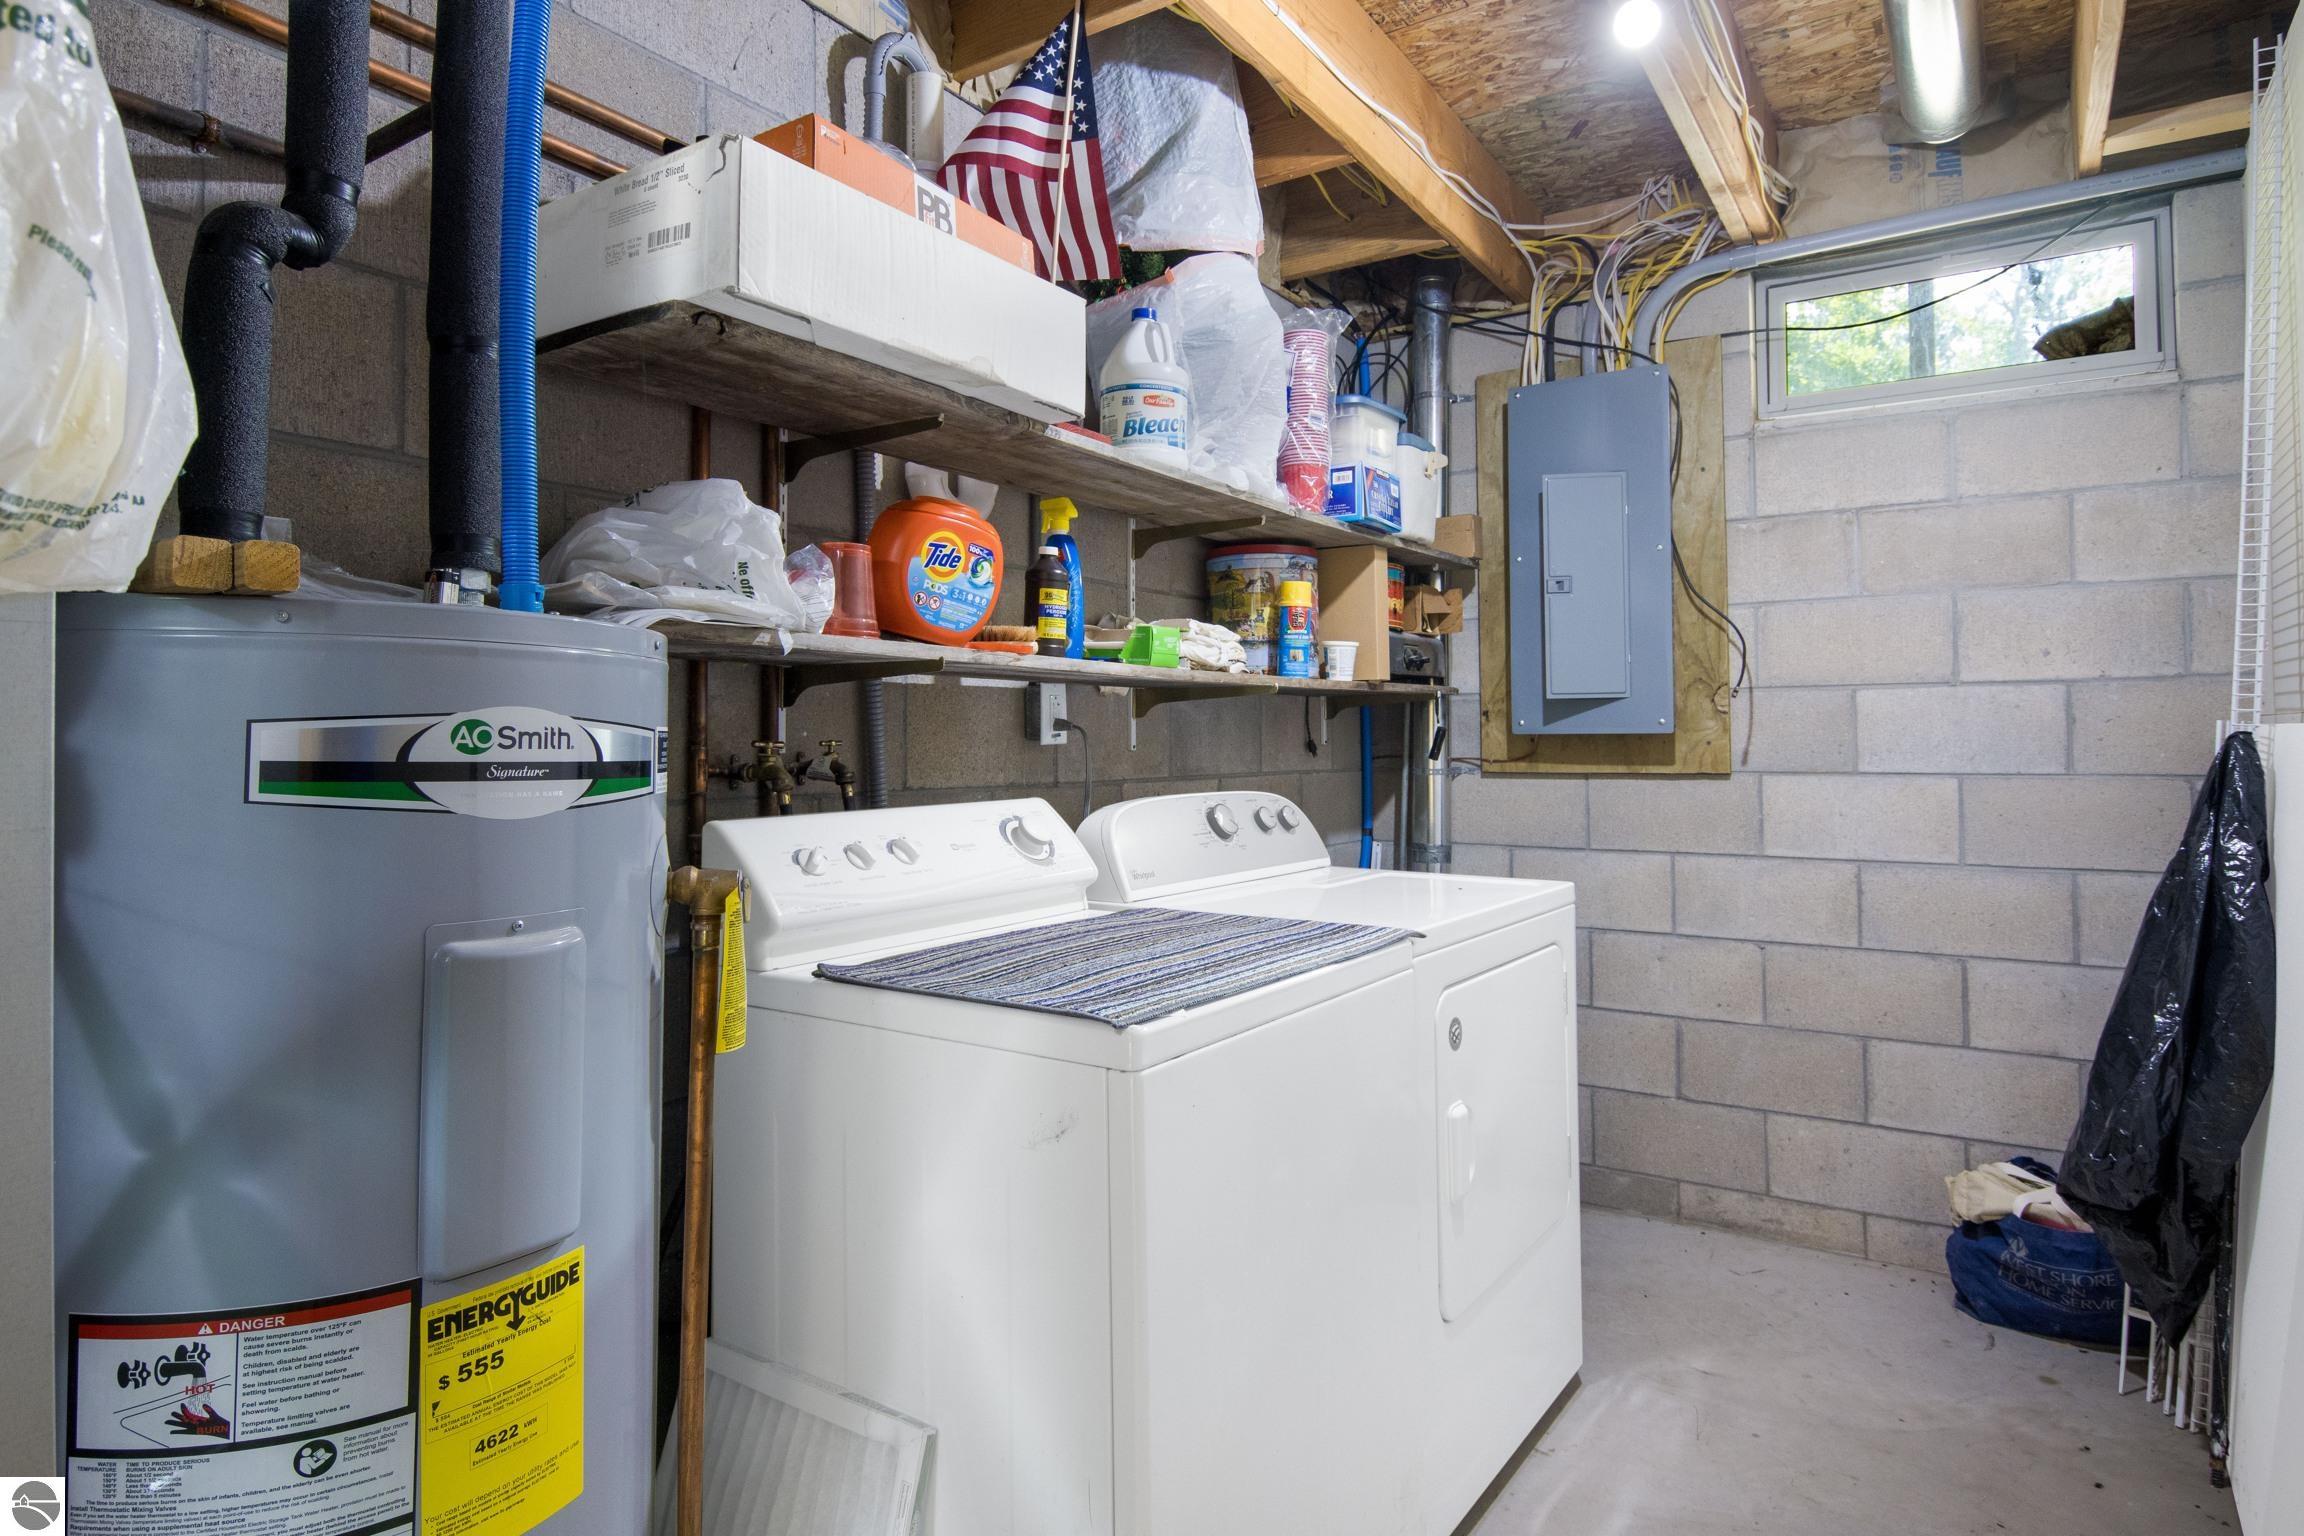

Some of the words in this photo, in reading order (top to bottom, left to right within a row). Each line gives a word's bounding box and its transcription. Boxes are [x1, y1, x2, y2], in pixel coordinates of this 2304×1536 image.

[614, 184, 631, 197] White
[632, 176, 649, 190] Bread
[665, 163, 685, 178] Sliced
[917, 185, 953, 235] PB
[924, 543, 962, 569] Tide
[923, 580, 949, 595] PODS
[453, 725, 496, 749] AO
[2050, 1271, 2117, 1287] SHORE
[1999, 1267, 2056, 1298] HOME
[2060, 1295, 2122, 1311] SERVIC
[428, 1261, 580, 1343] ENERGYGUIDE
[220, 1316, 286, 1333] DANGER
[266, 1329, 309, 1339] temperature
[310, 1326, 326, 1334] over
[267, 1340, 290, 1348] severe
[292, 1336, 313, 1344] burns
[314, 1329, 344, 1340] instantly
[462, 1342, 495, 1359] Estimated
[497, 1333, 517, 1346] Yearly
[518, 1322, 538, 1338] Energy
[243, 1349, 263, 1358] death
[265, 1347, 281, 1355] from
[243, 1361, 275, 1370] Children,
[277, 1355, 307, 1366] disabled
[309, 1352, 322, 1360] and
[324, 1348, 347, 1358] elderly
[251, 1368, 278, 1378] highest
[280, 1364, 293, 1372] risk
[295, 1362, 302, 1370] of
[304, 1360, 324, 1369] being
[325, 1355, 354, 1365] scalded.
[438, 1375, 451, 1391] $
[457, 1349, 505, 1383] 555
[242, 1389, 267, 1397] setting
[268, 1382, 311, 1394] temperature
[321, 1376, 341, 1384] water
[342, 1371, 366, 1380] heater.
[258, 1377, 296, 1387] instruction
[297, 1372, 324, 1381] manual
[325, 1367, 348, 1376] before
[185, 1384, 216, 1395] HOT
[280, 1395, 303, 1403] before
[304, 1389, 331, 1399] bathing
[242, 1407, 281, 1416] showering.
[242, 1416, 286, 1428] Temperature
[287, 1410, 314, 1421] limiting
[315, 1407, 338, 1415] valves
[196, 1425, 228, 1434] BURN
[241, 1427, 274, 1436] available,
[291, 1418, 318, 1428] manual.
[358, 1428, 382, 1439] manual
[393, 1421, 409, 1430] more
[343, 1443, 377, 1456] preventing
[378, 1438, 396, 1447] burns
[344, 1436, 379, 1449] information
[380, 1431, 398, 1439] about
[474, 1423, 520, 1454] 4622
[343, 1454, 358, 1462] from
[359, 1451, 370, 1459] hot
[472, 1451, 497, 1467] Estimated
[498, 1444, 513, 1456] Yearly
[513, 1437, 529, 1448] Energy
[424, 1513, 443, 1524] Your
[444, 1506, 461, 1517] cost
[461, 1499, 474, 1510] will
[474, 1485, 501, 1504] depend
[502, 1481, 511, 1490] on
[512, 1473, 527, 1486] your
[528, 1465, 543, 1477] utility
[545, 1455, 558, 1467] rates
[559, 1448, 570, 1457] and
[570, 1440, 580, 1450] use
[70, 1524, 112, 1532] Requirements
[157, 1522, 203, 1532] supplemental
